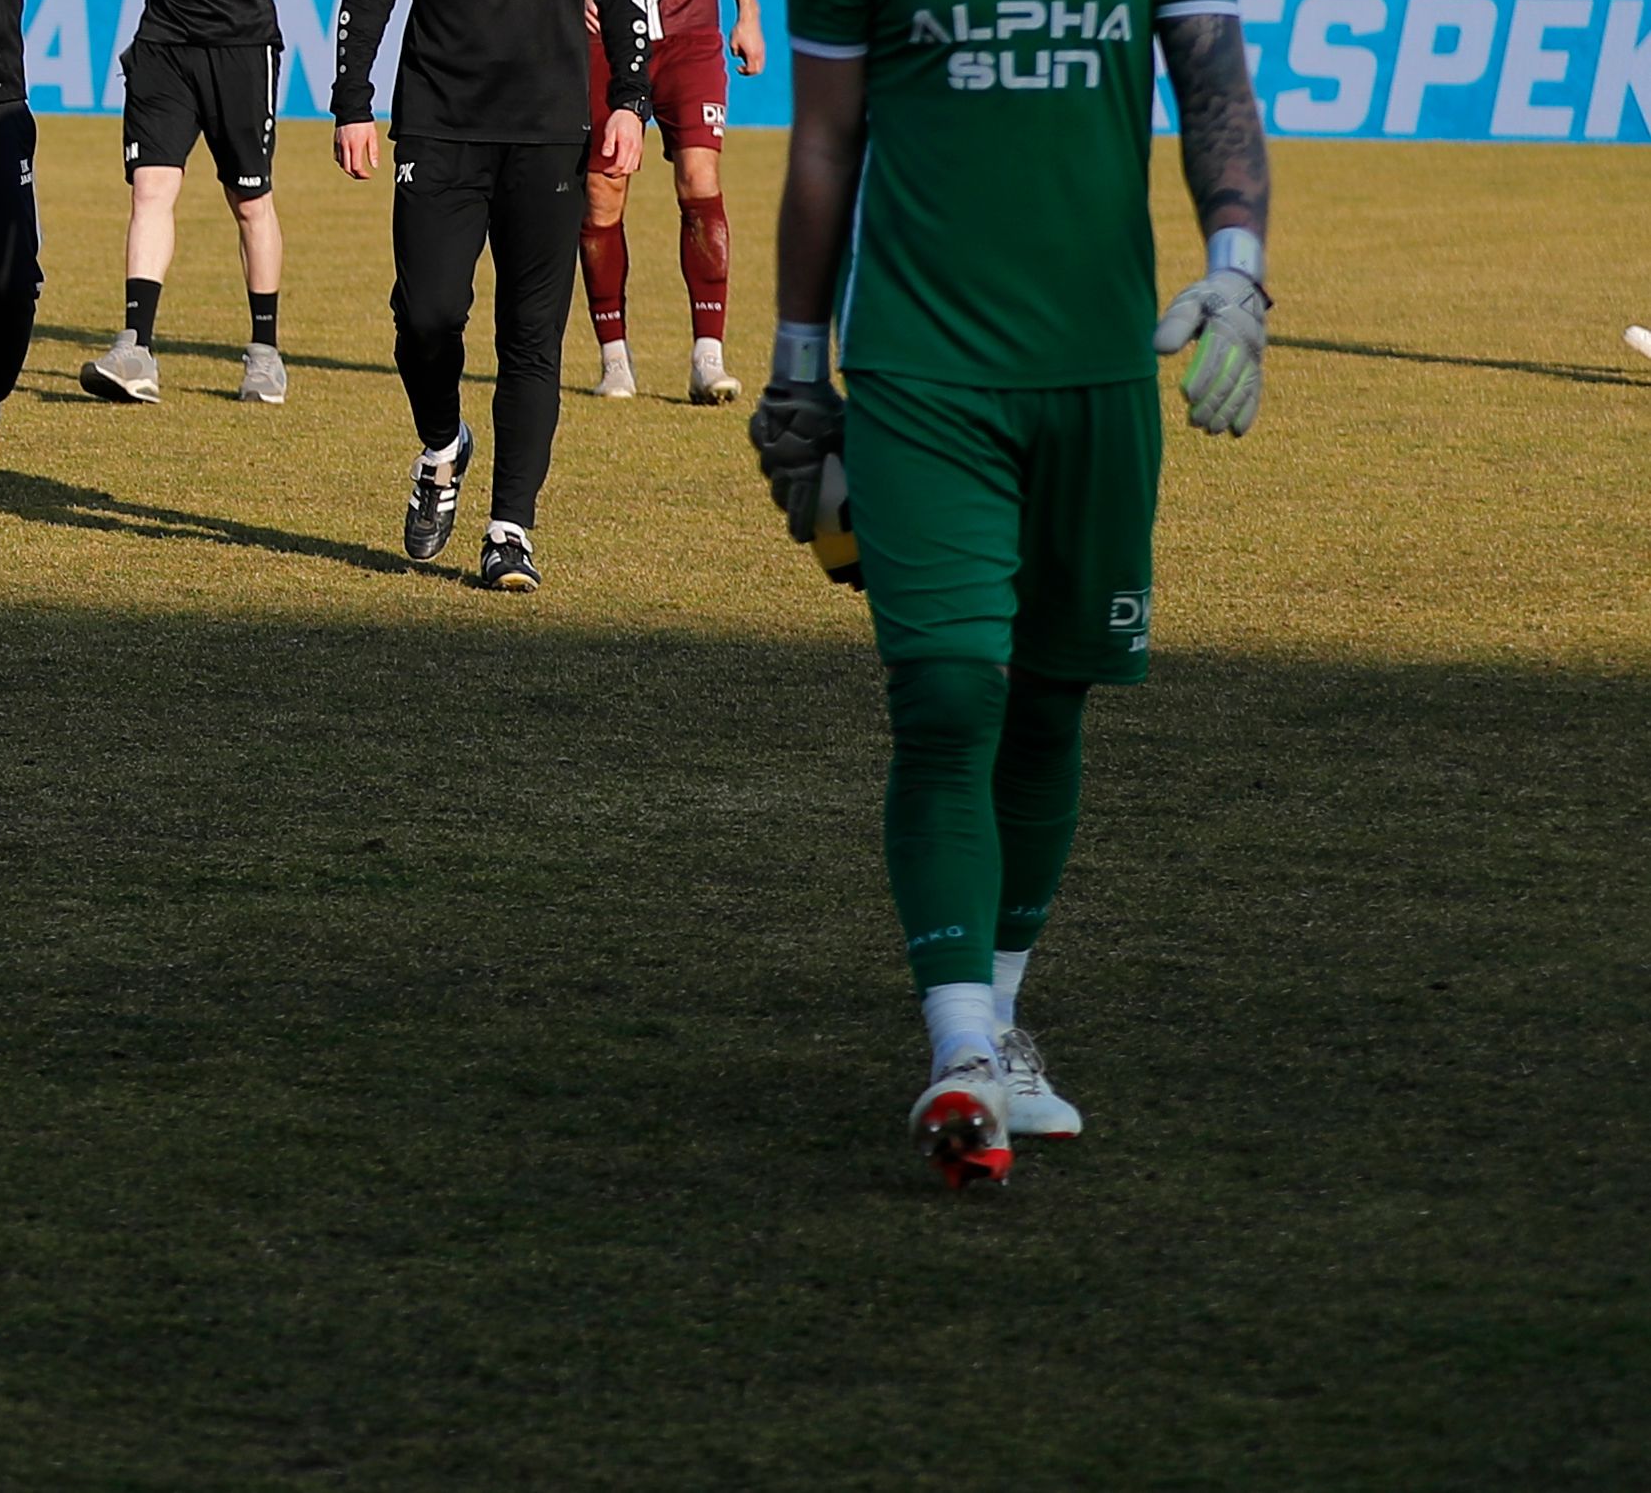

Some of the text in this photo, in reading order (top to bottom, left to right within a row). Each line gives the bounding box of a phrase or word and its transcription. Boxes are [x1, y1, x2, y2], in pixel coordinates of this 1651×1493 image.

[908, 0, 1133, 44] ALPHA
[947, 49, 1102, 90] SUN
[238, 176, 262, 188] JAKO
